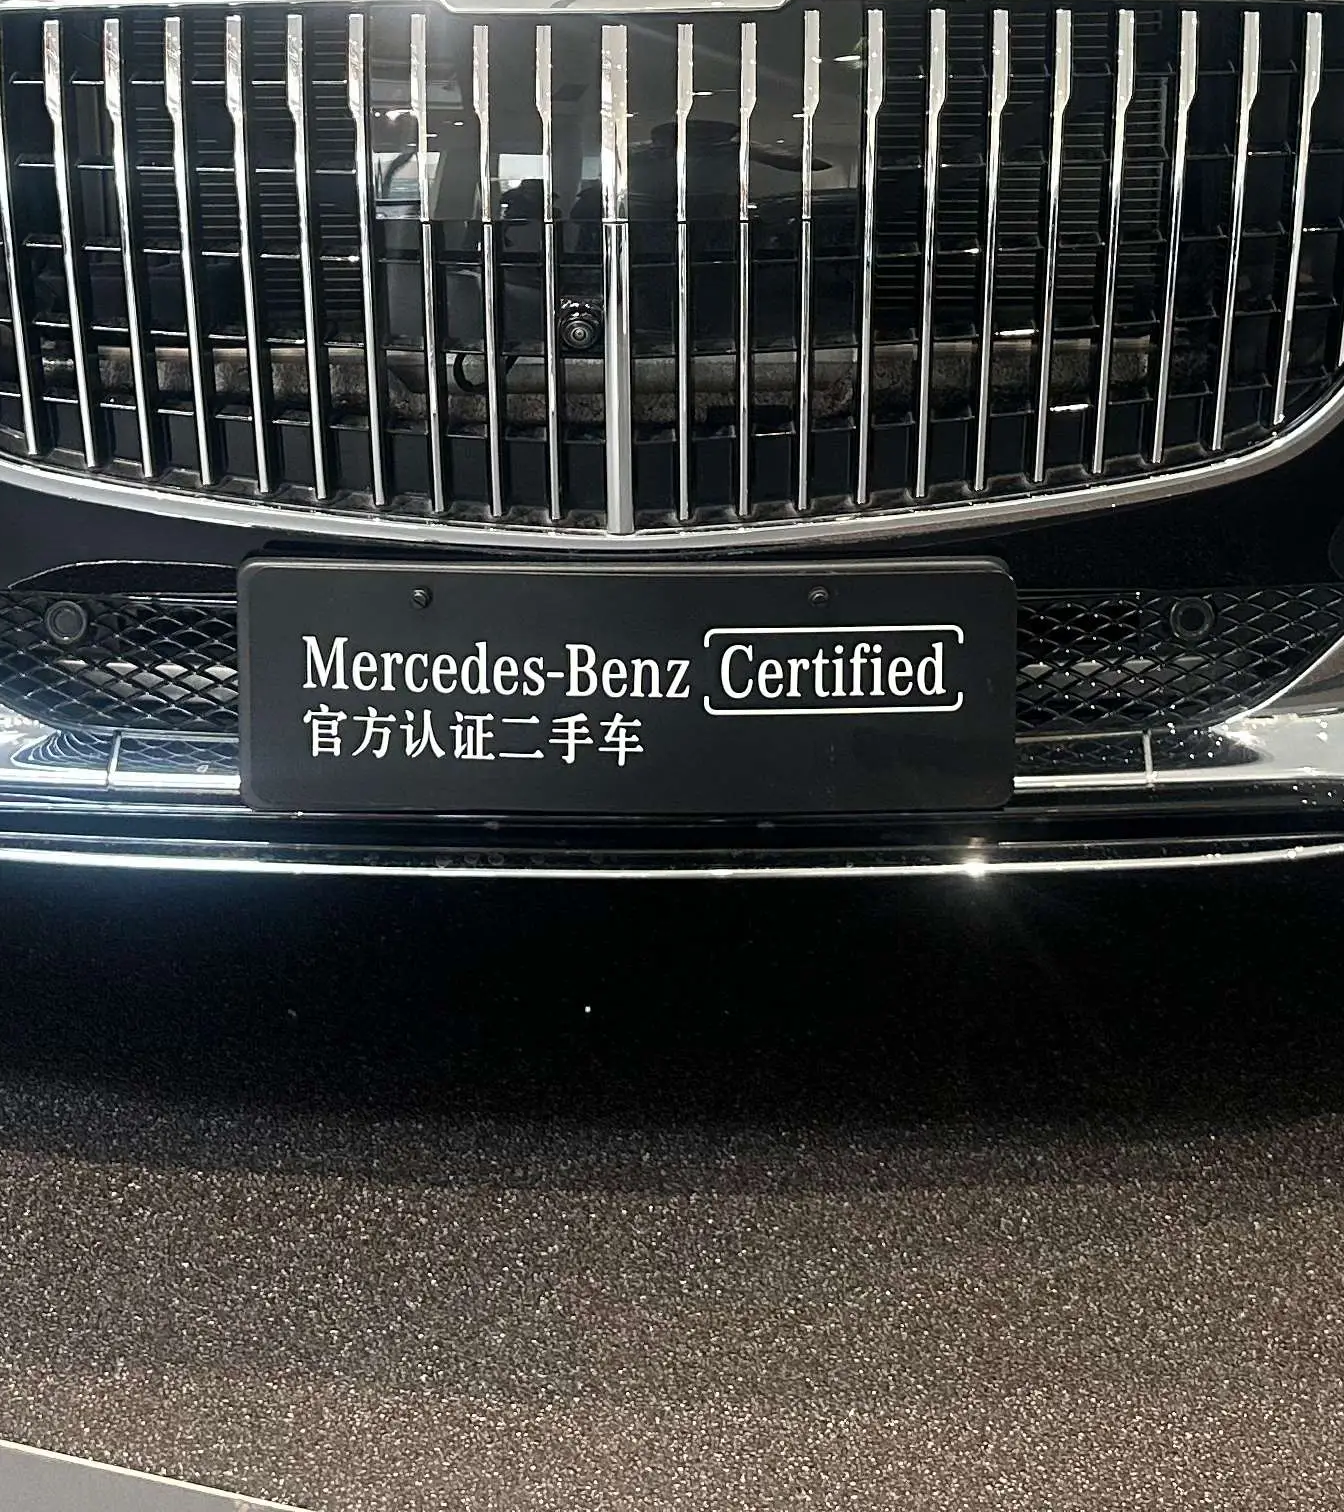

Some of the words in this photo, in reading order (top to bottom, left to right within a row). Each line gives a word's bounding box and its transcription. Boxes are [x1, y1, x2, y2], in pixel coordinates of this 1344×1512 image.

[302, 635, 691, 699] Mercedes-Benz
[720, 642, 947, 700] Certified
[302, 705, 644, 768] 官方认证二手车
